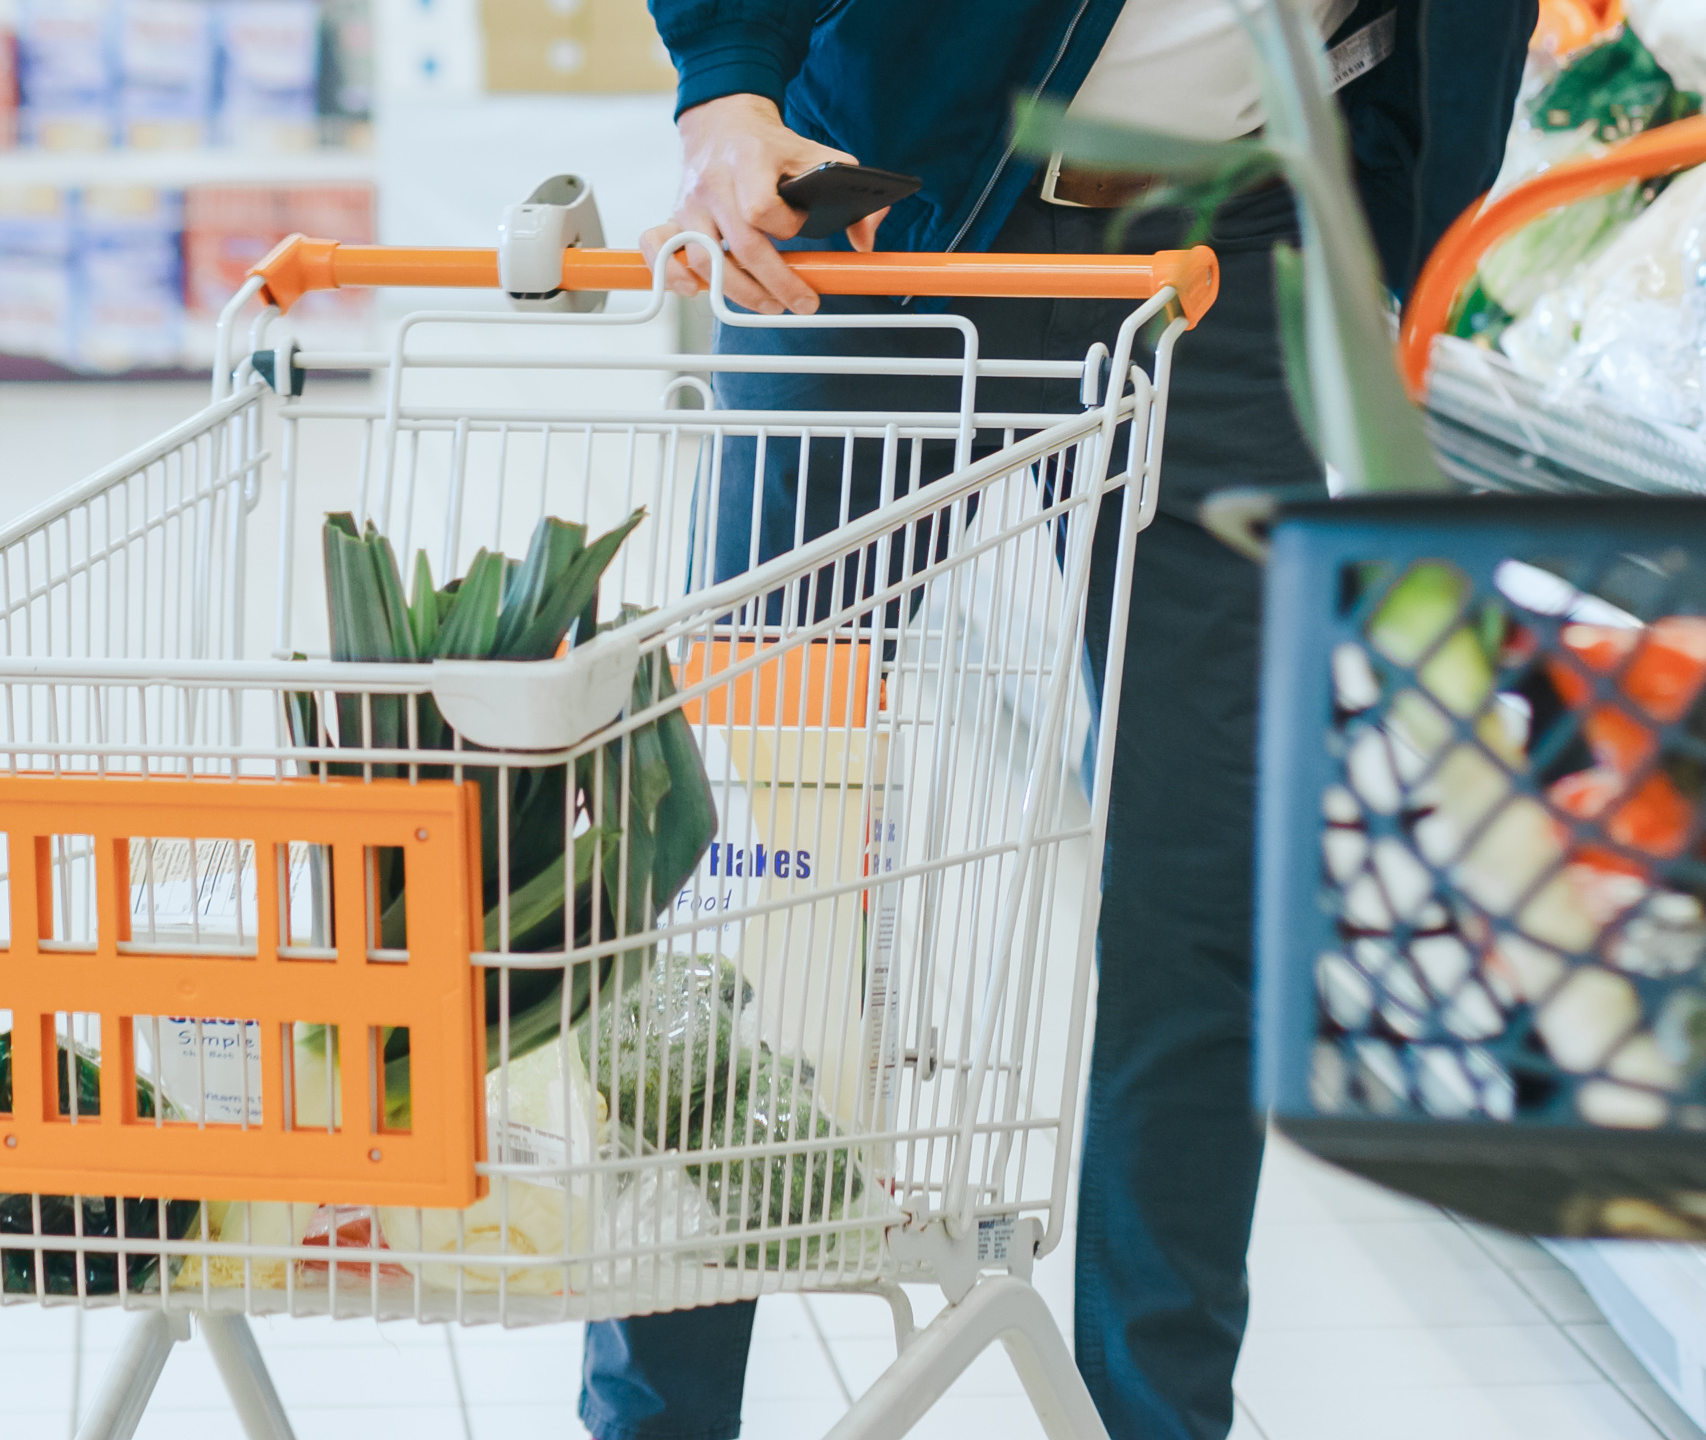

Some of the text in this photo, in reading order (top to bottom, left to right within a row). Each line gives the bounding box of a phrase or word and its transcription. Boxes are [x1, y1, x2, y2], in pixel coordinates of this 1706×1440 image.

[709, 842, 811, 879] Flakes
[677, 888, 733, 911] Food
[178, 1030, 255, 1050] Simple
